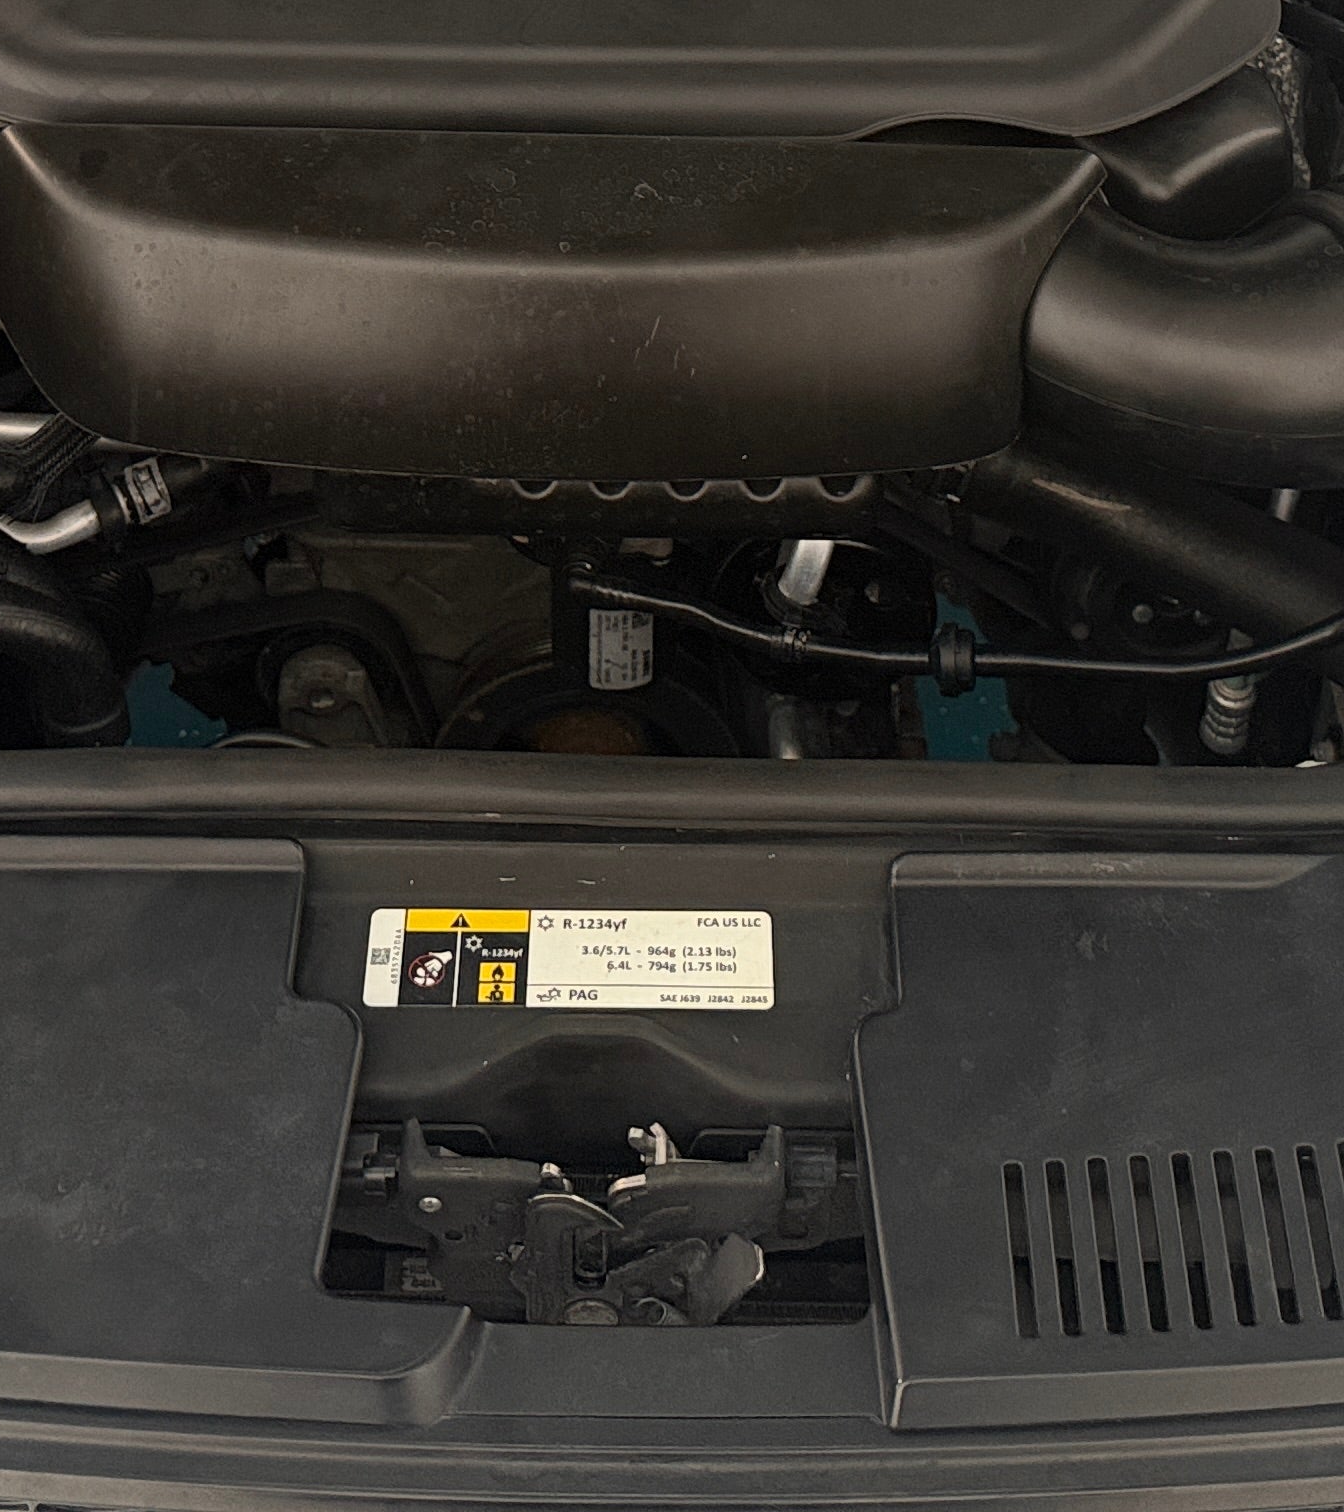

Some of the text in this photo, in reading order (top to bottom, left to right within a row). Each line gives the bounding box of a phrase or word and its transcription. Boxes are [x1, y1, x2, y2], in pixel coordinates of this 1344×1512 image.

[563, 918, 628, 932] R-1234yf
[697, 918, 762, 928] FCA US LLC
[481, 948, 524, 960] R-1234yf
[582, 945, 632, 957] 3.6/5.7L
[647, 946, 677, 958] 964g
[682, 945, 712, 958] (2.13
[715, 945, 737, 958] lbs)
[607, 960, 632, 970] 6.4L
[648, 960, 677, 973] 794g
[682, 961, 712, 973] (1.75
[715, 961, 737, 974] lbs)
[569, 989, 599, 1001] PAG
[659, 994, 678, 1003] SAE
[680, 994, 701, 1003] J639
[708, 995, 734, 1004] J2842
